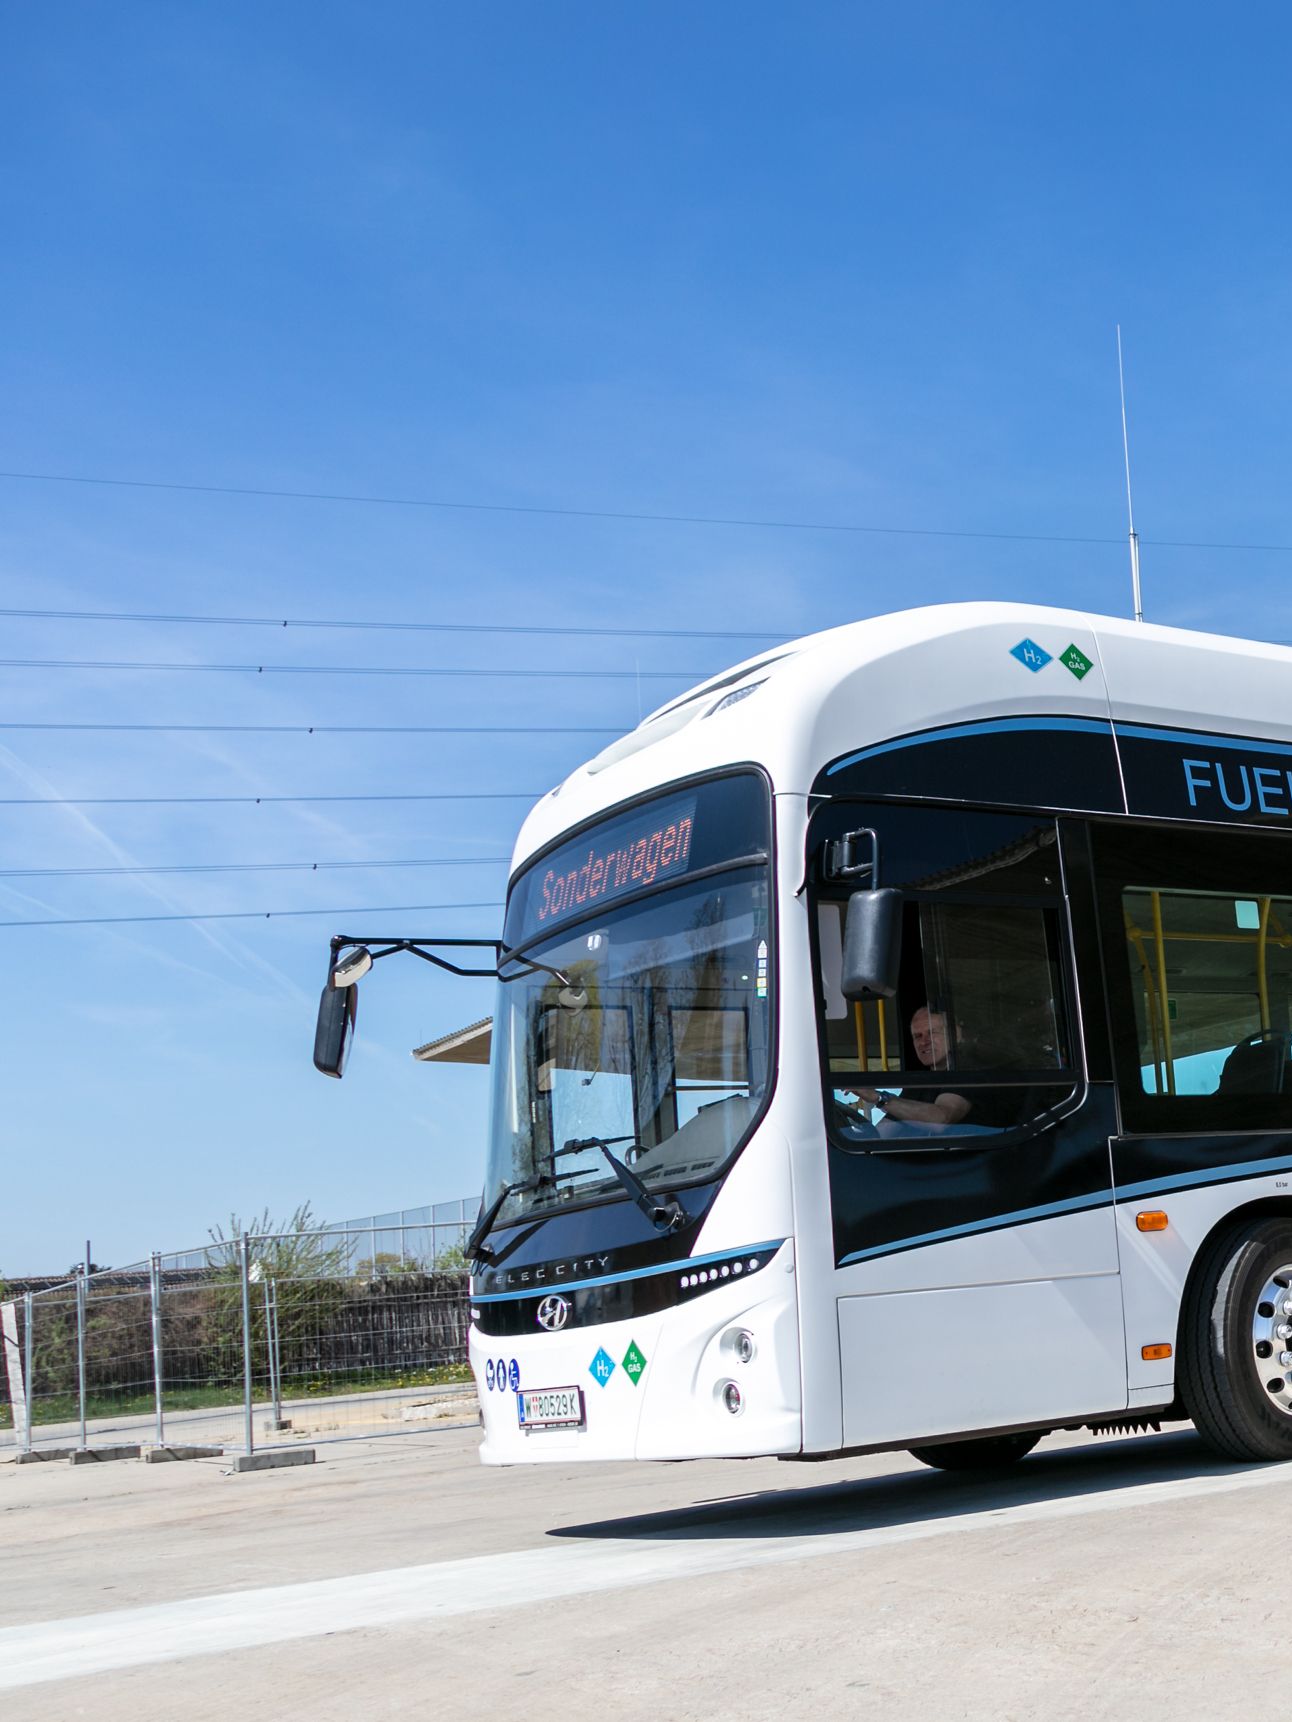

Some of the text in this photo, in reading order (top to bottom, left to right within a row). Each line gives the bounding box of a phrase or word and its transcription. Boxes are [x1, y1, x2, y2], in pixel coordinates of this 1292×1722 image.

[1068, 661, 1085, 671] GAS
[537, 817, 693, 920] Sonderwagen
[627, 1363, 642, 1373] GAS
